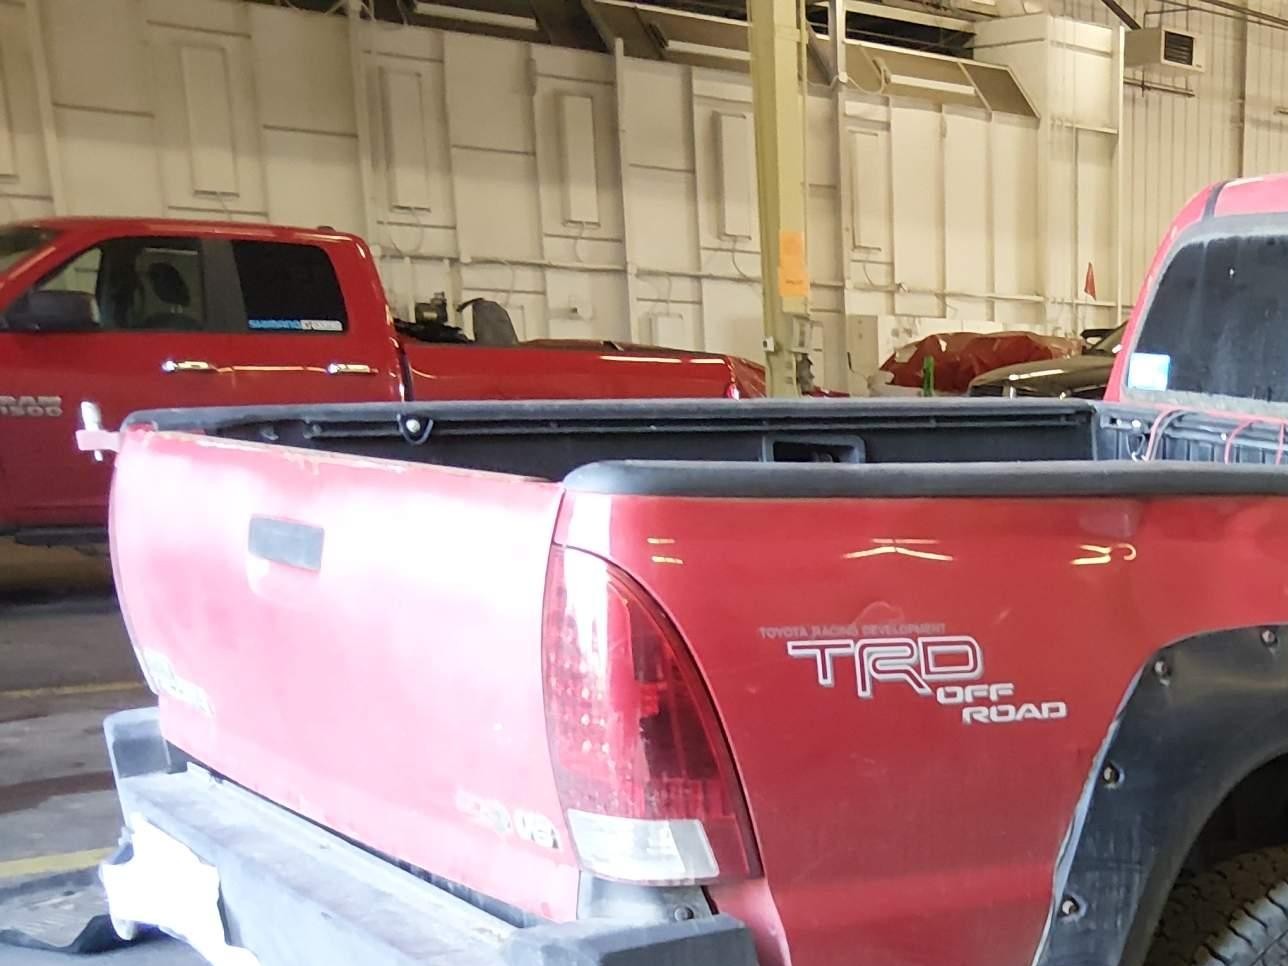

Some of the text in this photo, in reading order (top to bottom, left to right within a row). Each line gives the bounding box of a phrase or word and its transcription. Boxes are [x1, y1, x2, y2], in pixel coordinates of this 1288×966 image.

[759, 622, 946, 639] TOYOTA RACING DEVELOPMENT
[787, 635, 983, 698] TRD
[936, 683, 1014, 705] OFF
[962, 701, 1068, 724] ROAD
